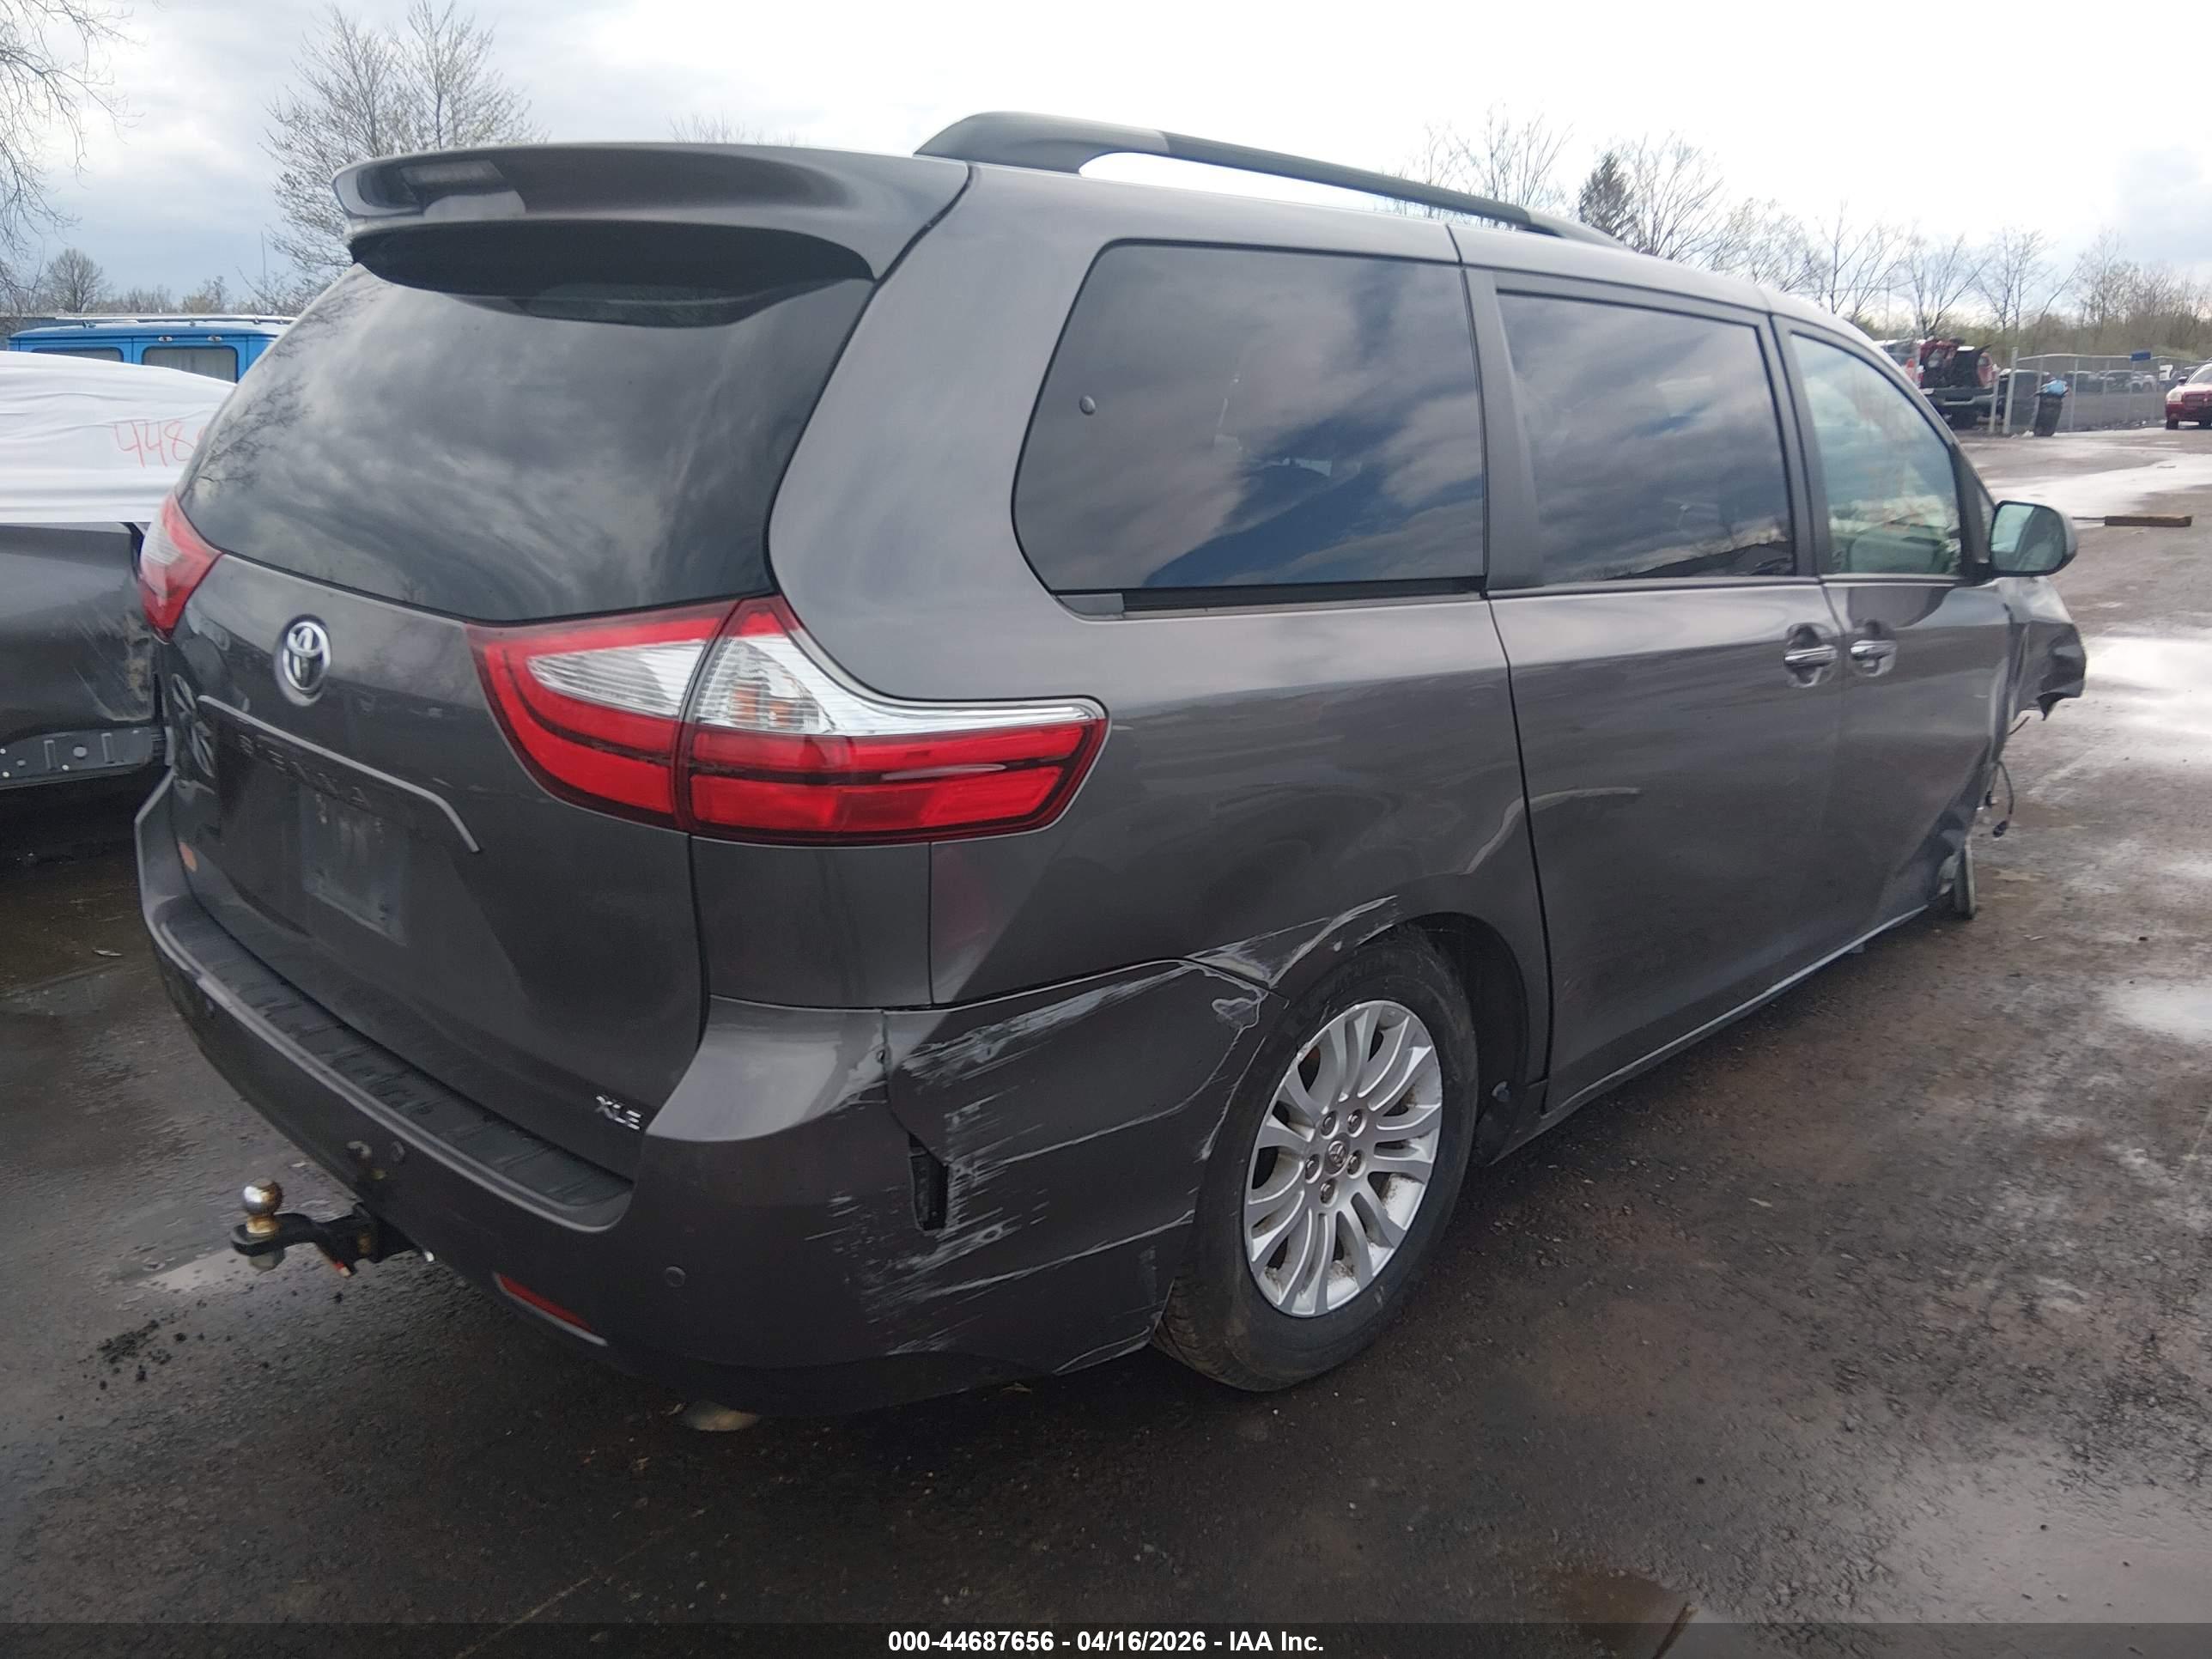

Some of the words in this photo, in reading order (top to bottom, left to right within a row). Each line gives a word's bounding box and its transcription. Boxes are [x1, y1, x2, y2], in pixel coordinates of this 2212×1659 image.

[113, 419, 205, 468] 448
[239, 734, 373, 807] SIENNA
[594, 1093, 642, 1131] XLE
